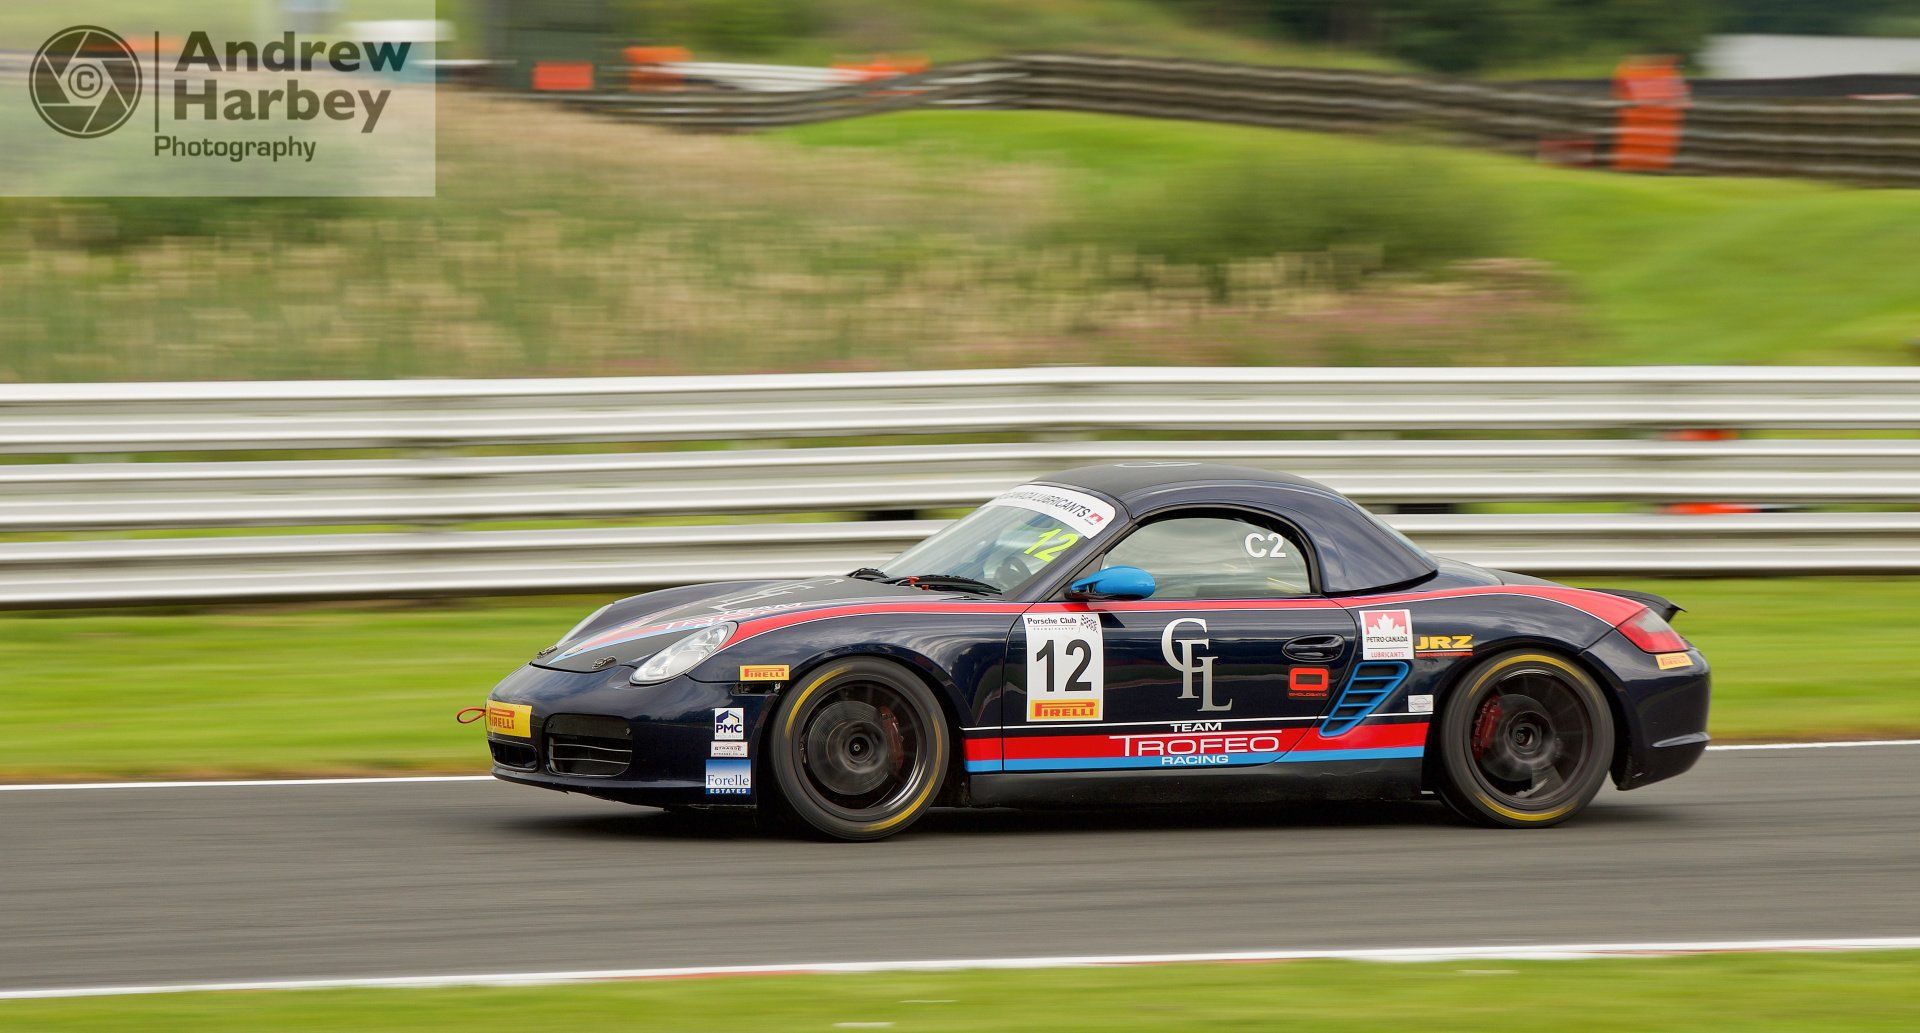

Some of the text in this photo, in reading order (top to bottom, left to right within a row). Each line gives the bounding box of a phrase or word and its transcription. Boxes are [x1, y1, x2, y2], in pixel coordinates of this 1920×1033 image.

[1023, 528, 1079, 563] 12
[1244, 532, 1287, 558] C2
[1027, 617, 1058, 625] Porsche
[1415, 635, 1473, 650] JRZ
[1036, 639, 1092, 692] 12
[744, 668, 785, 678] PIRELLI
[1035, 702, 1096, 717] PIRELLI
[716, 725, 743, 733] PMC
[1170, 722, 1222, 732] TEAM
[1109, 730, 1282, 757] TROFEO
[1161, 755, 1229, 765] RACING
[707, 774, 750, 786] Forelle
